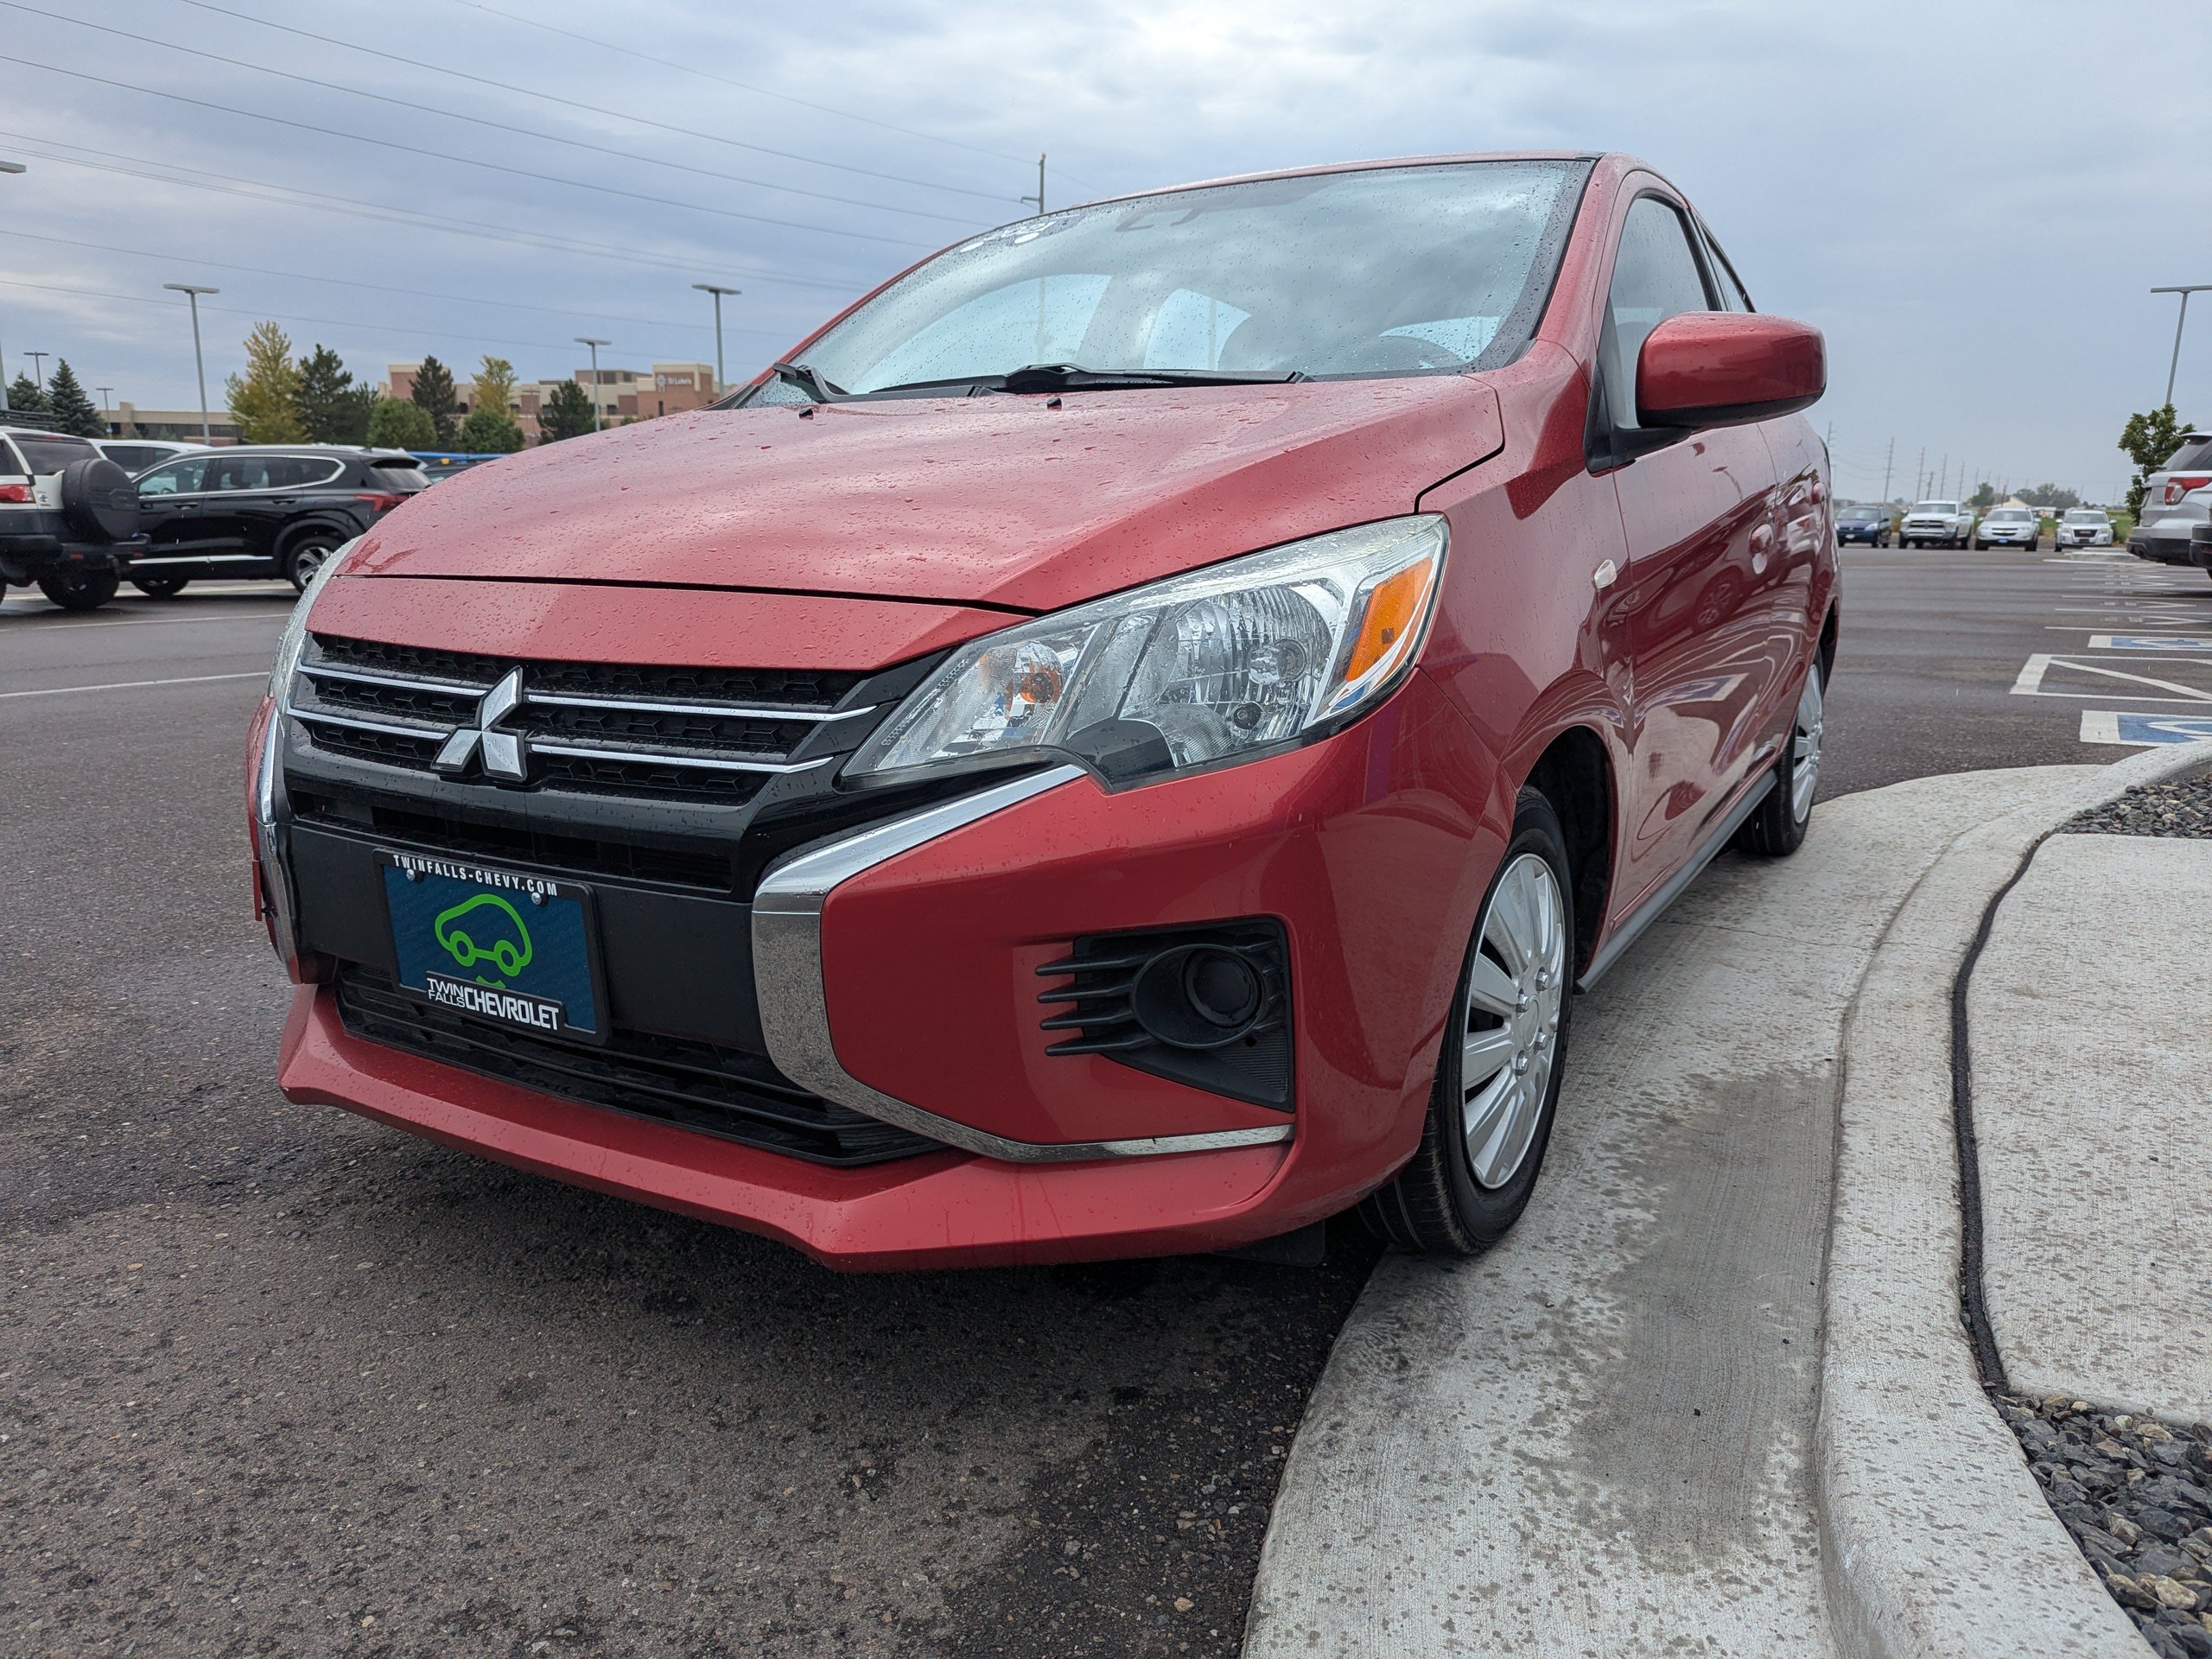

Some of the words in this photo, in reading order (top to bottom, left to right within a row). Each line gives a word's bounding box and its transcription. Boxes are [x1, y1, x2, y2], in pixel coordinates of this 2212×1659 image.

[393, 855, 557, 896] TWINFALLS-CHEVY.COM
[427, 978, 464, 997] TWIN
[429, 989, 465, 1007] FALLS
[464, 987, 559, 1030] CHEVROLET
